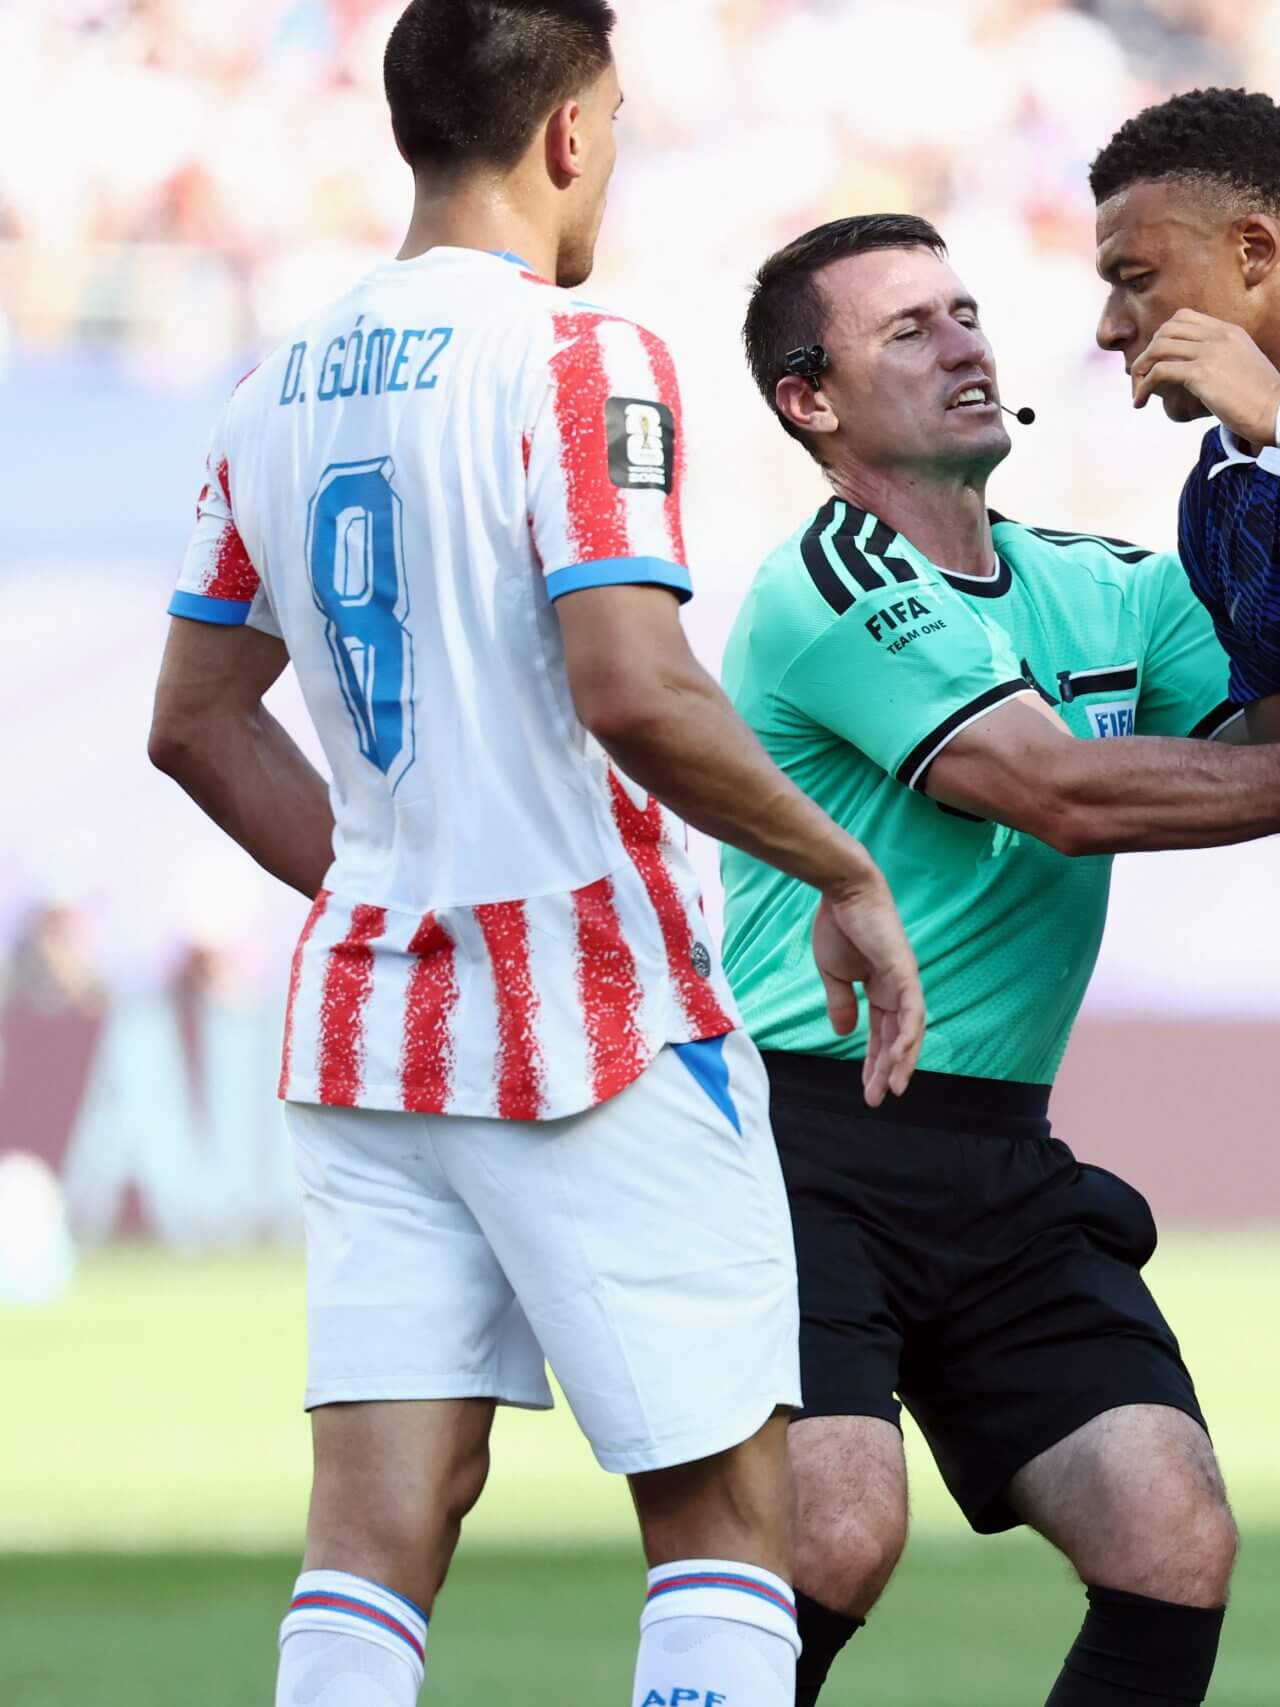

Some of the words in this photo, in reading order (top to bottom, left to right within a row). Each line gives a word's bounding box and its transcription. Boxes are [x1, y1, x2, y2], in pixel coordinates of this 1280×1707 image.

[279, 340, 306, 406] D.
[317, 314, 455, 402] GÓMEZ
[865, 597, 931, 643] FIFA
[886, 629, 921, 655] TEAM
[921, 619, 948, 635] ONE
[1094, 708, 1134, 738] FIFA
